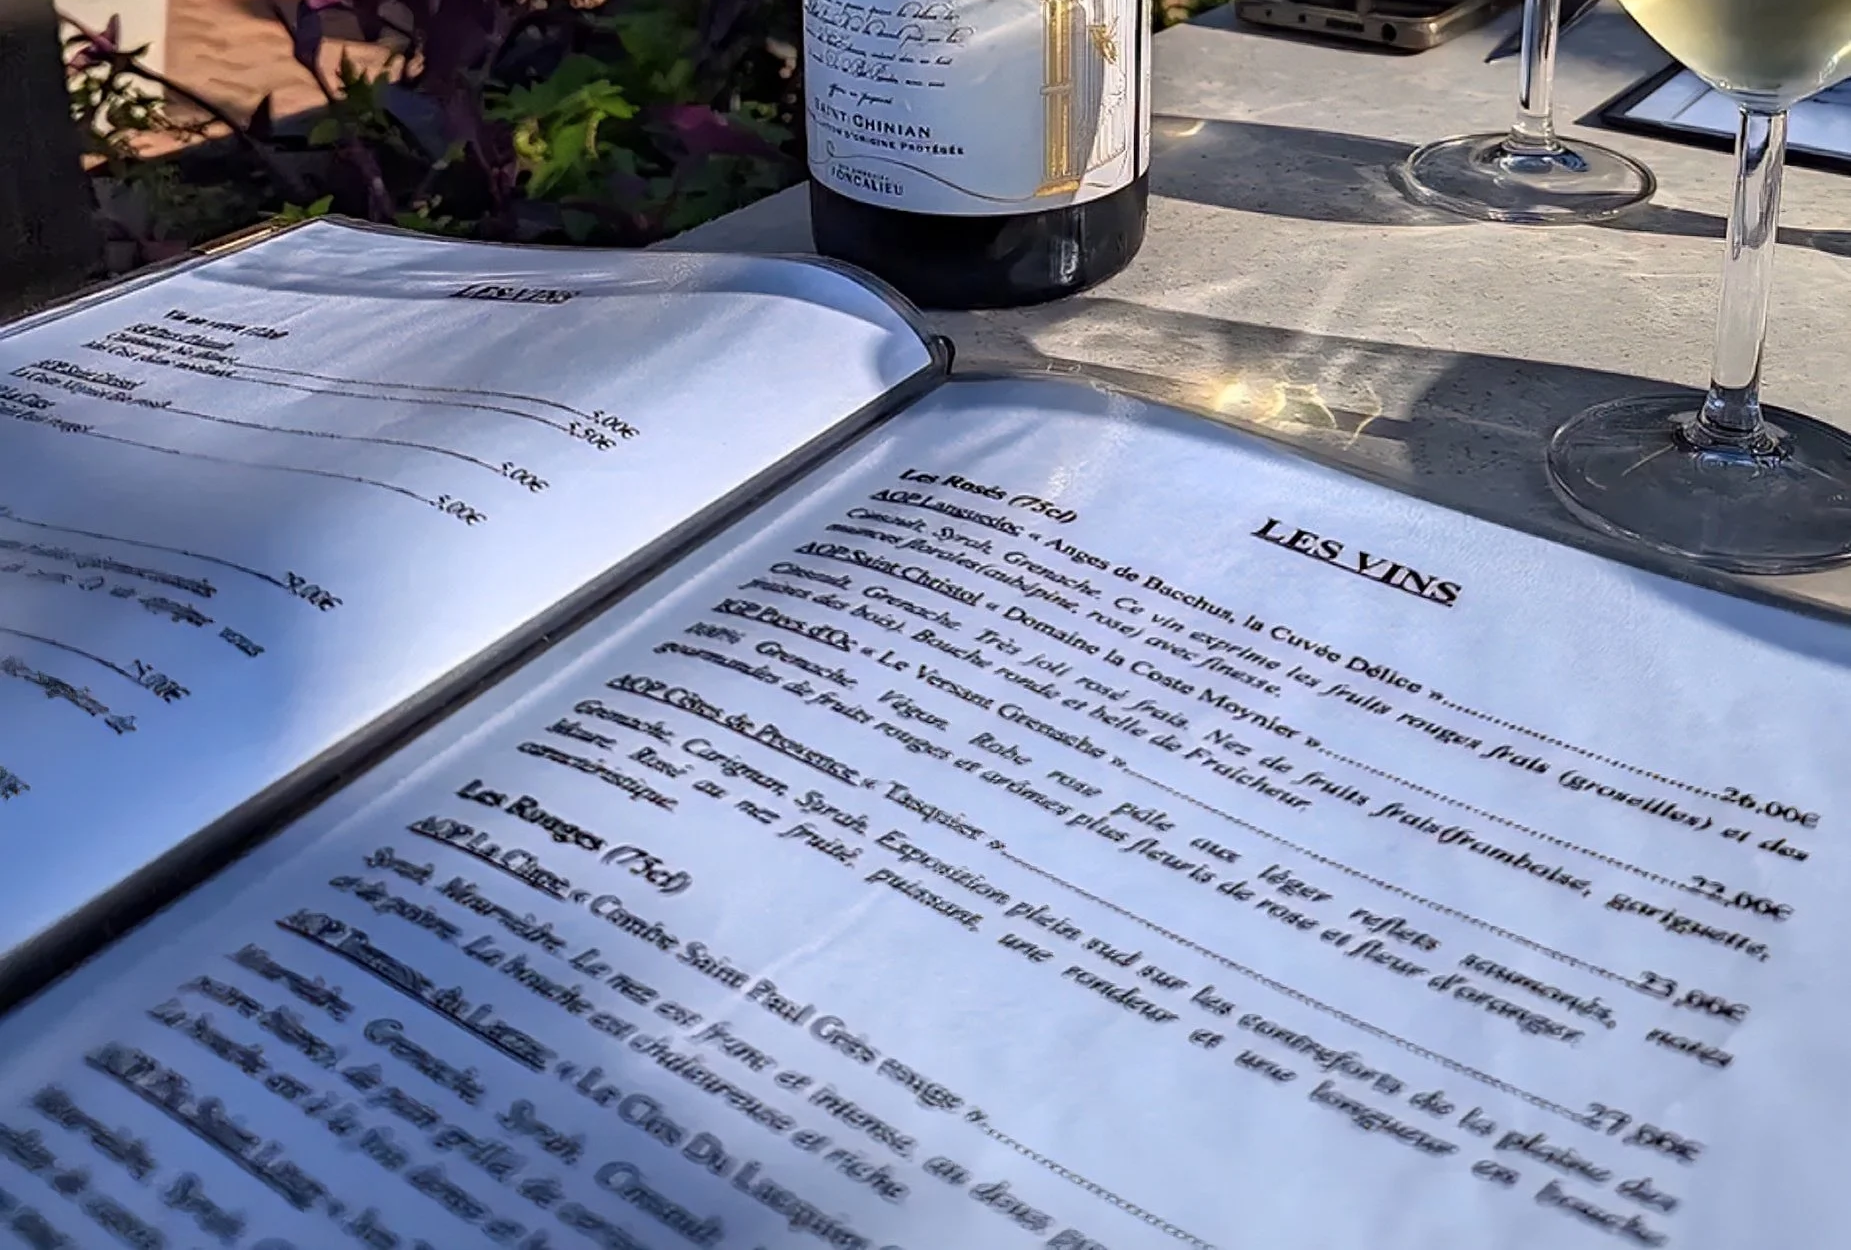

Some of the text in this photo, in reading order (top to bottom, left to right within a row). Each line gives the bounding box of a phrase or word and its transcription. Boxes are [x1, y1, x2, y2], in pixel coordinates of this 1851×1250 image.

[852, 113, 932, 139] CHINIAN
[898, 468, 1078, 524] Les Rosés (75cl)
[1250, 518, 1462, 607] LES VINS
[605, 673, 668, 700] AOP
[793, 541, 851, 561] AOP
[839, 549, 902, 576] Saint
[893, 566, 985, 607] Christol
[1001, 605, 1100, 655] Domaine
[1102, 648, 1126, 667] la
[1129, 660, 1195, 695] Coste
[1197, 687, 1300, 739] Moynier
[869, 488, 923, 507] AOP
[1043, 538, 1110, 571] Anges
[1112, 566, 1140, 582] de
[1141, 575, 1235, 624] Bacchus,
[1242, 614, 1265, 632] la
[1269, 625, 1341, 663] Cuvée
[1344, 655, 1422, 693] Délice
[1719, 786, 1819, 828] 26,00€
[909, 628, 993, 669] Bouche
[993, 666, 1061, 700] ronde
[1060, 698, 1089, 711] et
[1087, 704, 1149, 737] belle
[1147, 733, 1183, 753] de
[1085, 610, 1145, 639] rose)
[1143, 636, 1200, 662] avec
[1192, 656, 1281, 698] finesse.
[876, 649, 910, 672] Le
[915, 663, 995, 710] Versant
[996, 703, 1107, 759] Grenache
[973, 628, 1022, 656] Très
[1020, 653, 1073, 678] joli
[1073, 676, 1130, 702] rosé
[1121, 699, 1189, 731] frais.
[1202, 728, 1253, 757] Nez
[1257, 755, 1294, 774] de
[1291, 771, 1370, 807] fruits
[1112, 596, 1145, 615] Ce
[1150, 613, 1185, 633] vin
[1188, 631, 1281, 670] exprime
[1285, 665, 1322, 688] les
[1318, 683, 1392, 715] fruits
[1395, 712, 1482, 750] rouges
[1479, 744, 1550, 774] frais
[1719, 827, 1751, 843] et
[1757, 837, 1809, 862] des
[455, 778, 690, 894] Les Rouges (75cl)
[872, 721, 954, 760] rouges
[952, 758, 982, 773] et
[1064, 812, 1130, 843] plus
[1122, 838, 1216, 884] fleuris
[1215, 881, 1256, 902] de
[1255, 898, 1319, 931] rose
[1319, 929, 1353, 948] et
[1343, 939, 1427, 976] fleur
[967, 731, 1032, 766] Robe
[1046, 770, 1103, 798] rose
[1189, 837, 1241, 864] aux
[1257, 863, 1333, 902] léger
[1349, 908, 1439, 951] reflets
[997, 933, 1054, 963] une
[1061, 965, 1179, 1022] rondeur
[1188, 1029, 1224, 1049] et
[1003, 901, 1082, 941] plein
[1085, 937, 1142, 968] sud
[1135, 964, 1188, 990] sur
[1189, 984, 1235, 1016] les
